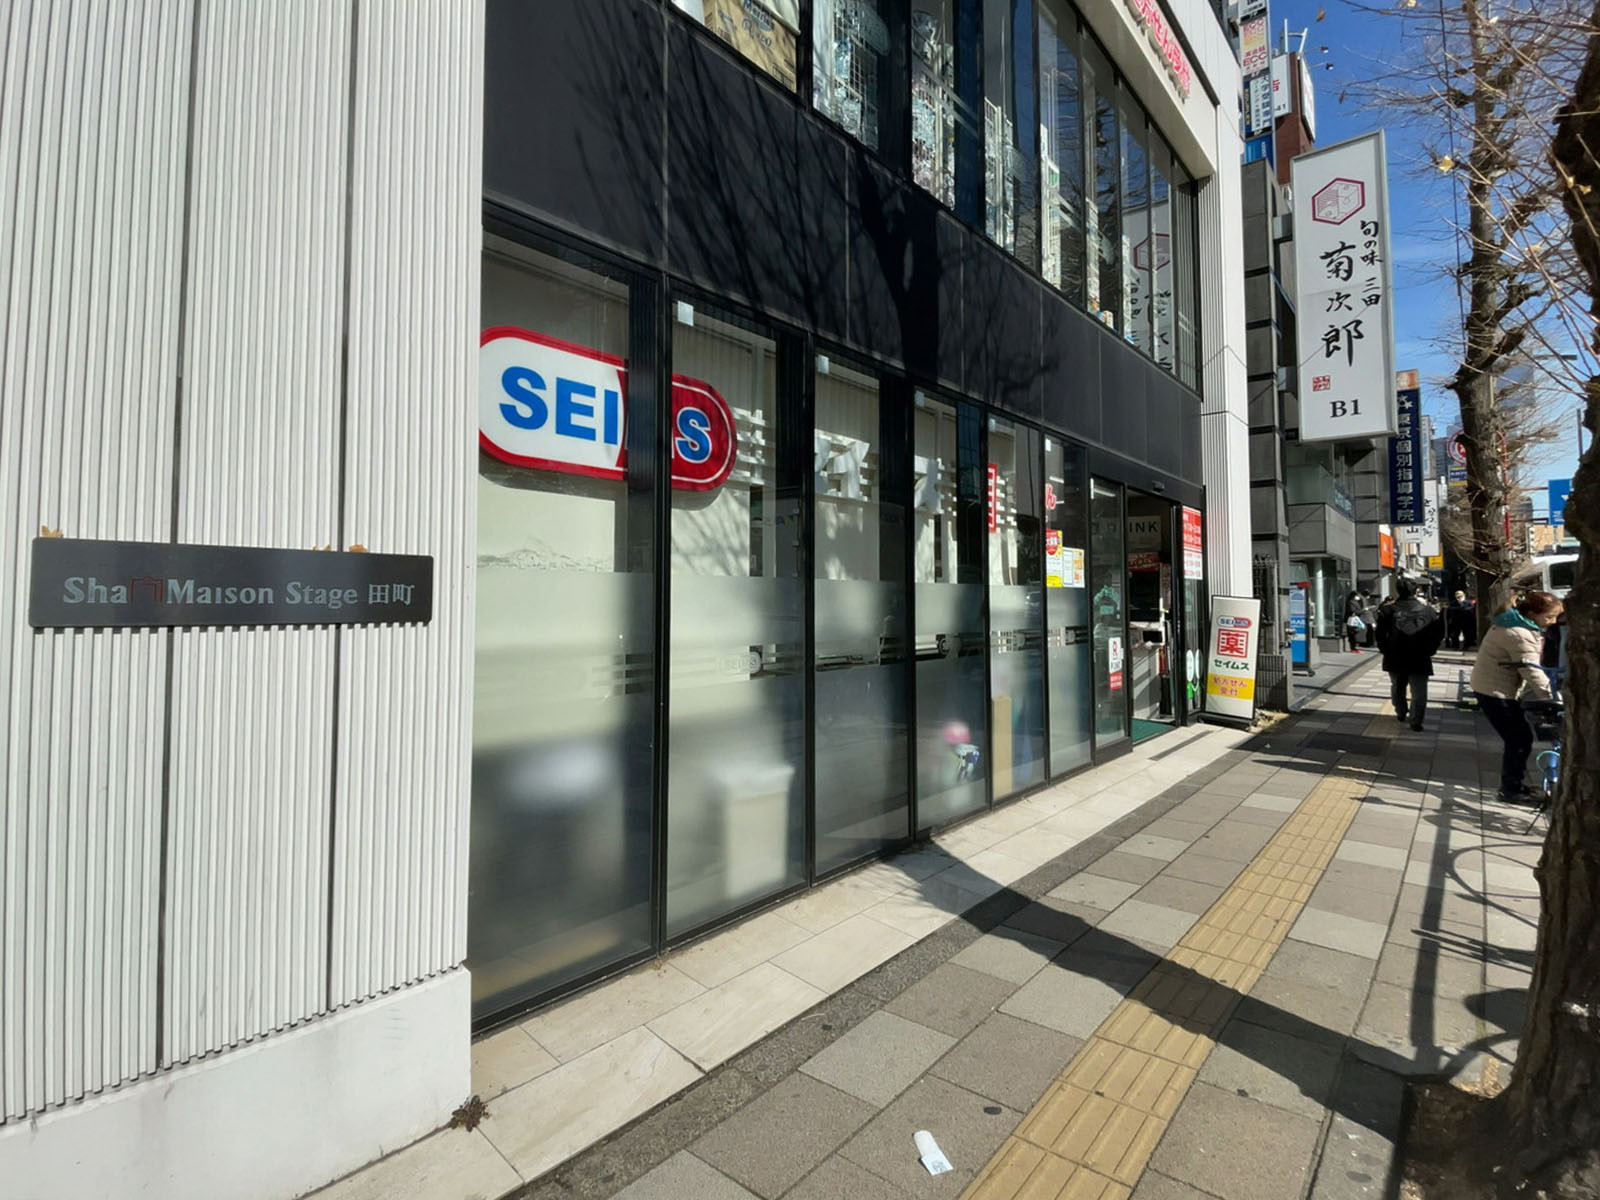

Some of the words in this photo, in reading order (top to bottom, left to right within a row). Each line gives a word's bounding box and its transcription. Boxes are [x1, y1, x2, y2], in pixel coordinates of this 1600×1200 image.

[1243, 52, 1268, 67] ECC
[1359, 219, 1383, 266] 旬の味
[1361, 276, 1381, 307] 三田
[1319, 240, 1364, 367] 菊次郎
[1330, 399, 1362, 418] B1
[63, 576, 128, 605] Sha
[166, 579, 274, 605] Maison
[285, 581, 358, 609] Stage
[367, 583, 415, 606] 田町
[1219, 631, 1246, 655] 薬
[1214, 659, 1250, 671] セイムス
[1213, 677, 1248, 688] 処方せん
[1219, 687, 1238, 697] 受付
